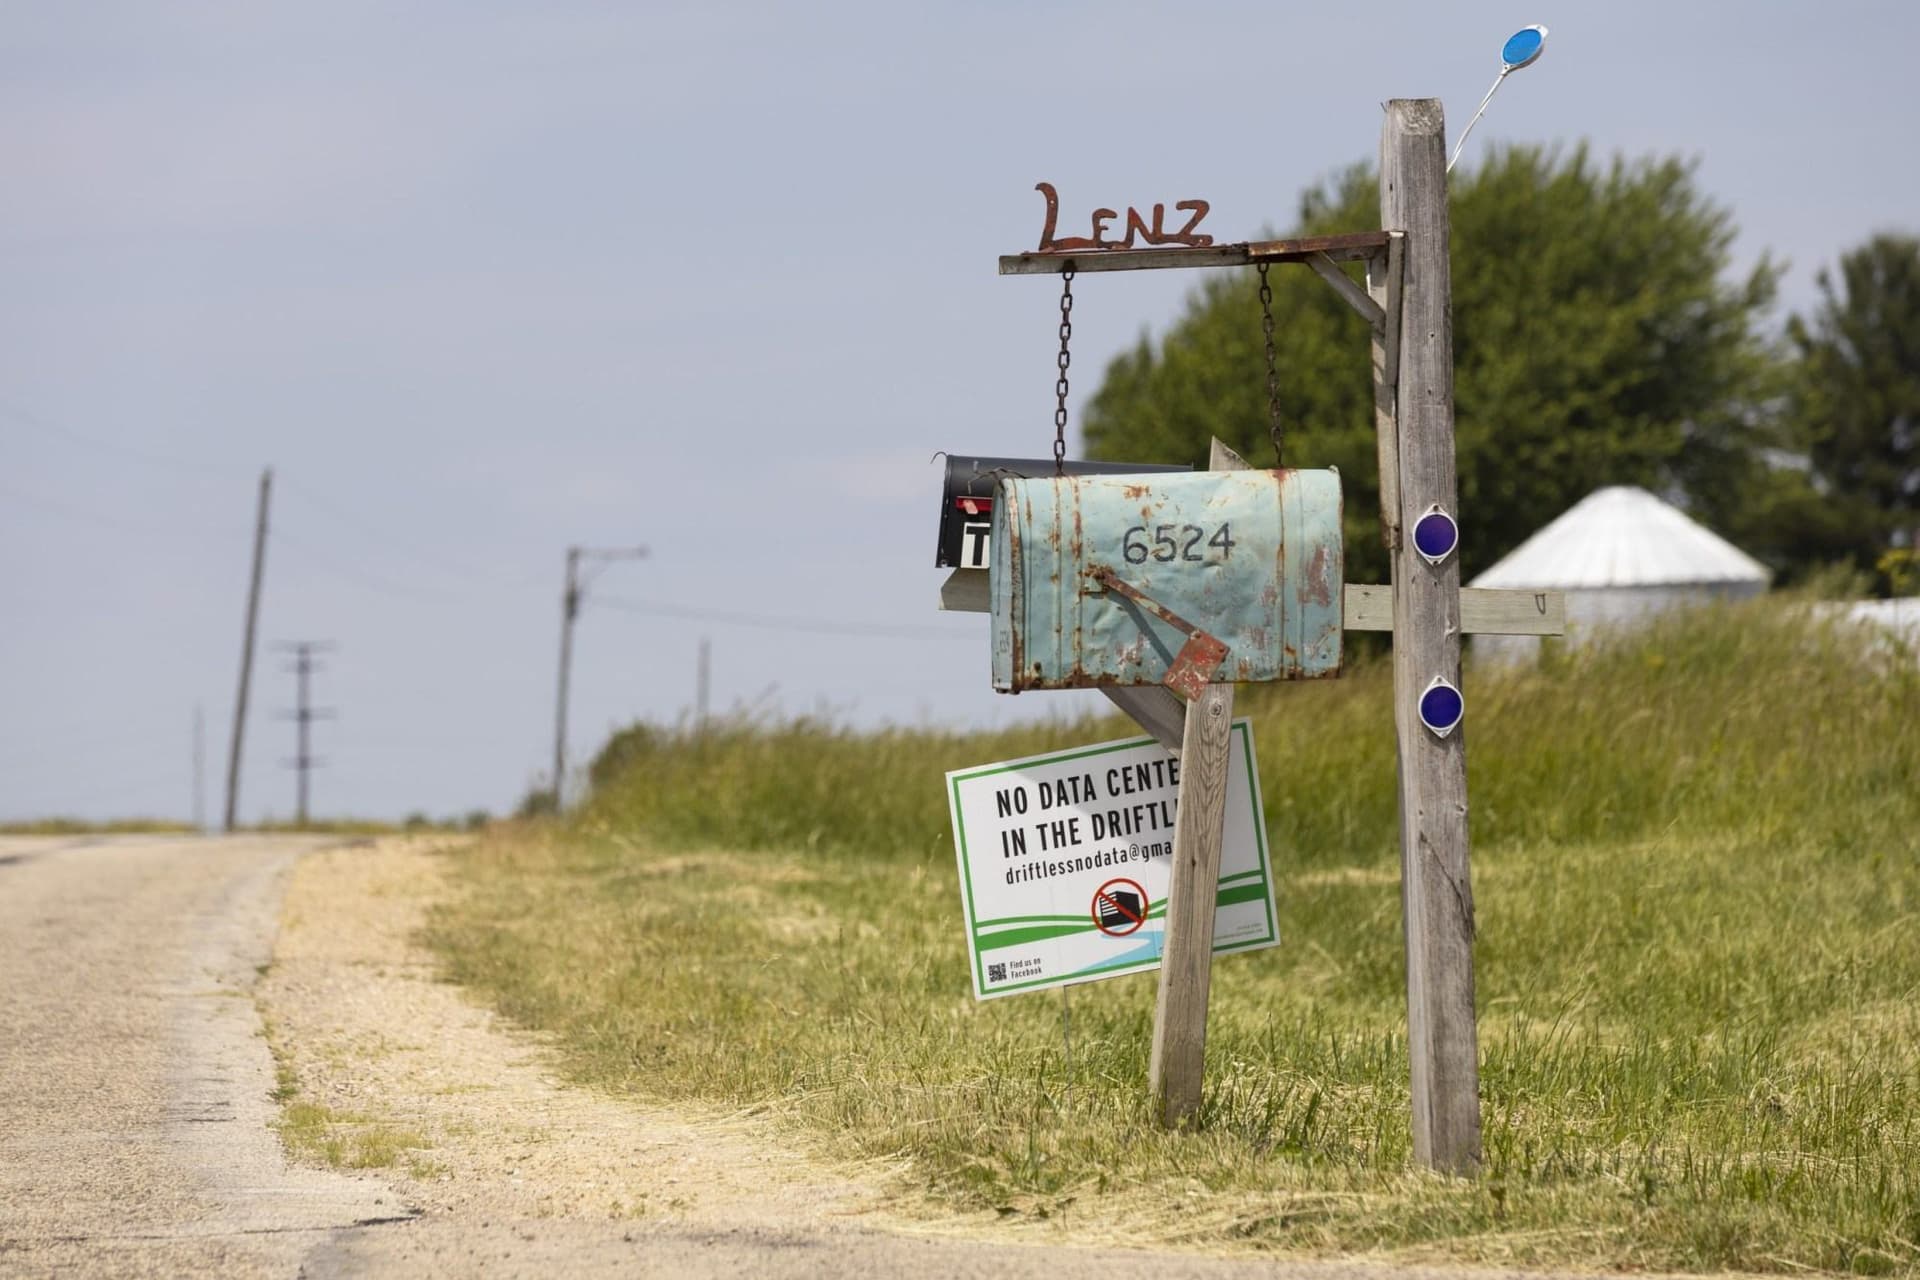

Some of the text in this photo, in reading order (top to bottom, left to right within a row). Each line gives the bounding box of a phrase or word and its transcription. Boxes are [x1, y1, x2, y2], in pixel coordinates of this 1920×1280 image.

[1034, 182, 1214, 252] LENZ
[1122, 521, 1236, 565] 6524
[996, 785, 1028, 818] NO
[1038, 773, 1097, 810] DATA
[1002, 798, 1179, 858] IN THE DRIFTL
[1006, 841, 1173, 884] driftlessnodata@gma
[1010, 957, 1041, 969] Find us on
[1011, 966, 1042, 979] Facebook
